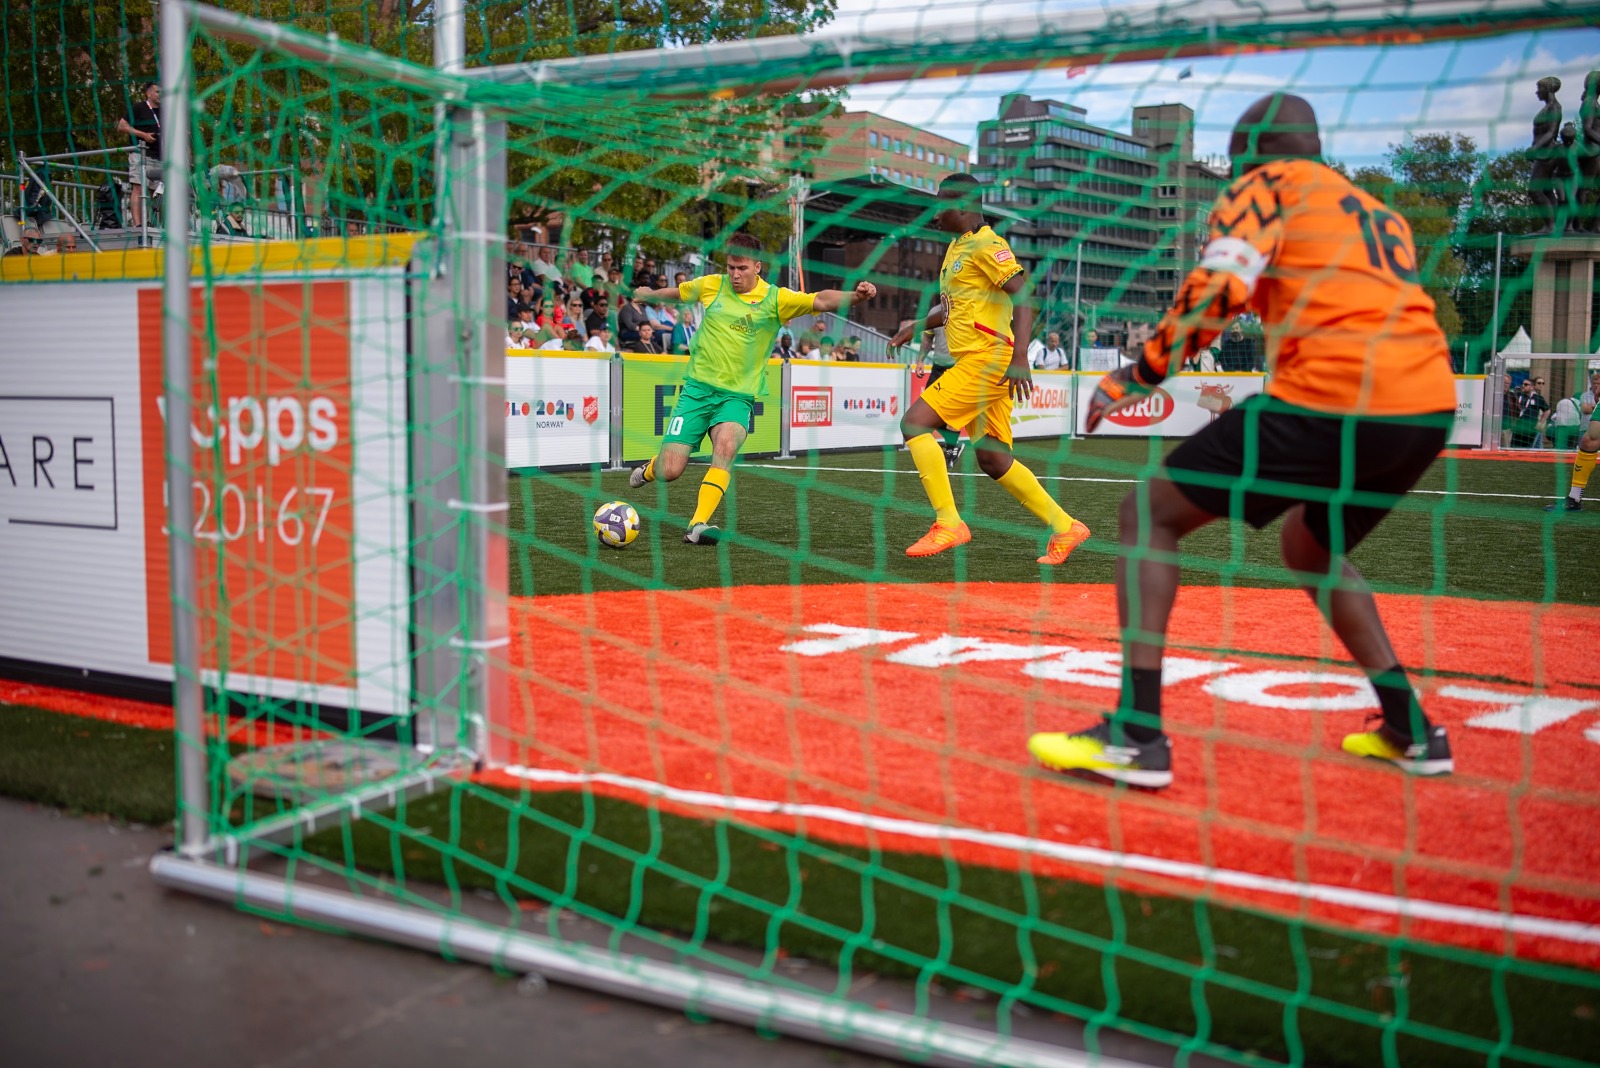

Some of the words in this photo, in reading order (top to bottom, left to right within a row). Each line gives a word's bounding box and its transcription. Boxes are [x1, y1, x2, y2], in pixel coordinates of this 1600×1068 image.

[1340, 195, 1418, 282] 16
[798, 400, 827, 411] HOMELESS
[1031, 385, 1069, 409] GLOBAL
[536, 421, 565, 429] NORWAY
[798, 412, 816, 422] WORLD
[817, 412, 827, 422] CUP
[156, 396, 338, 467] pps
[161, 480, 336, 547] 20167
